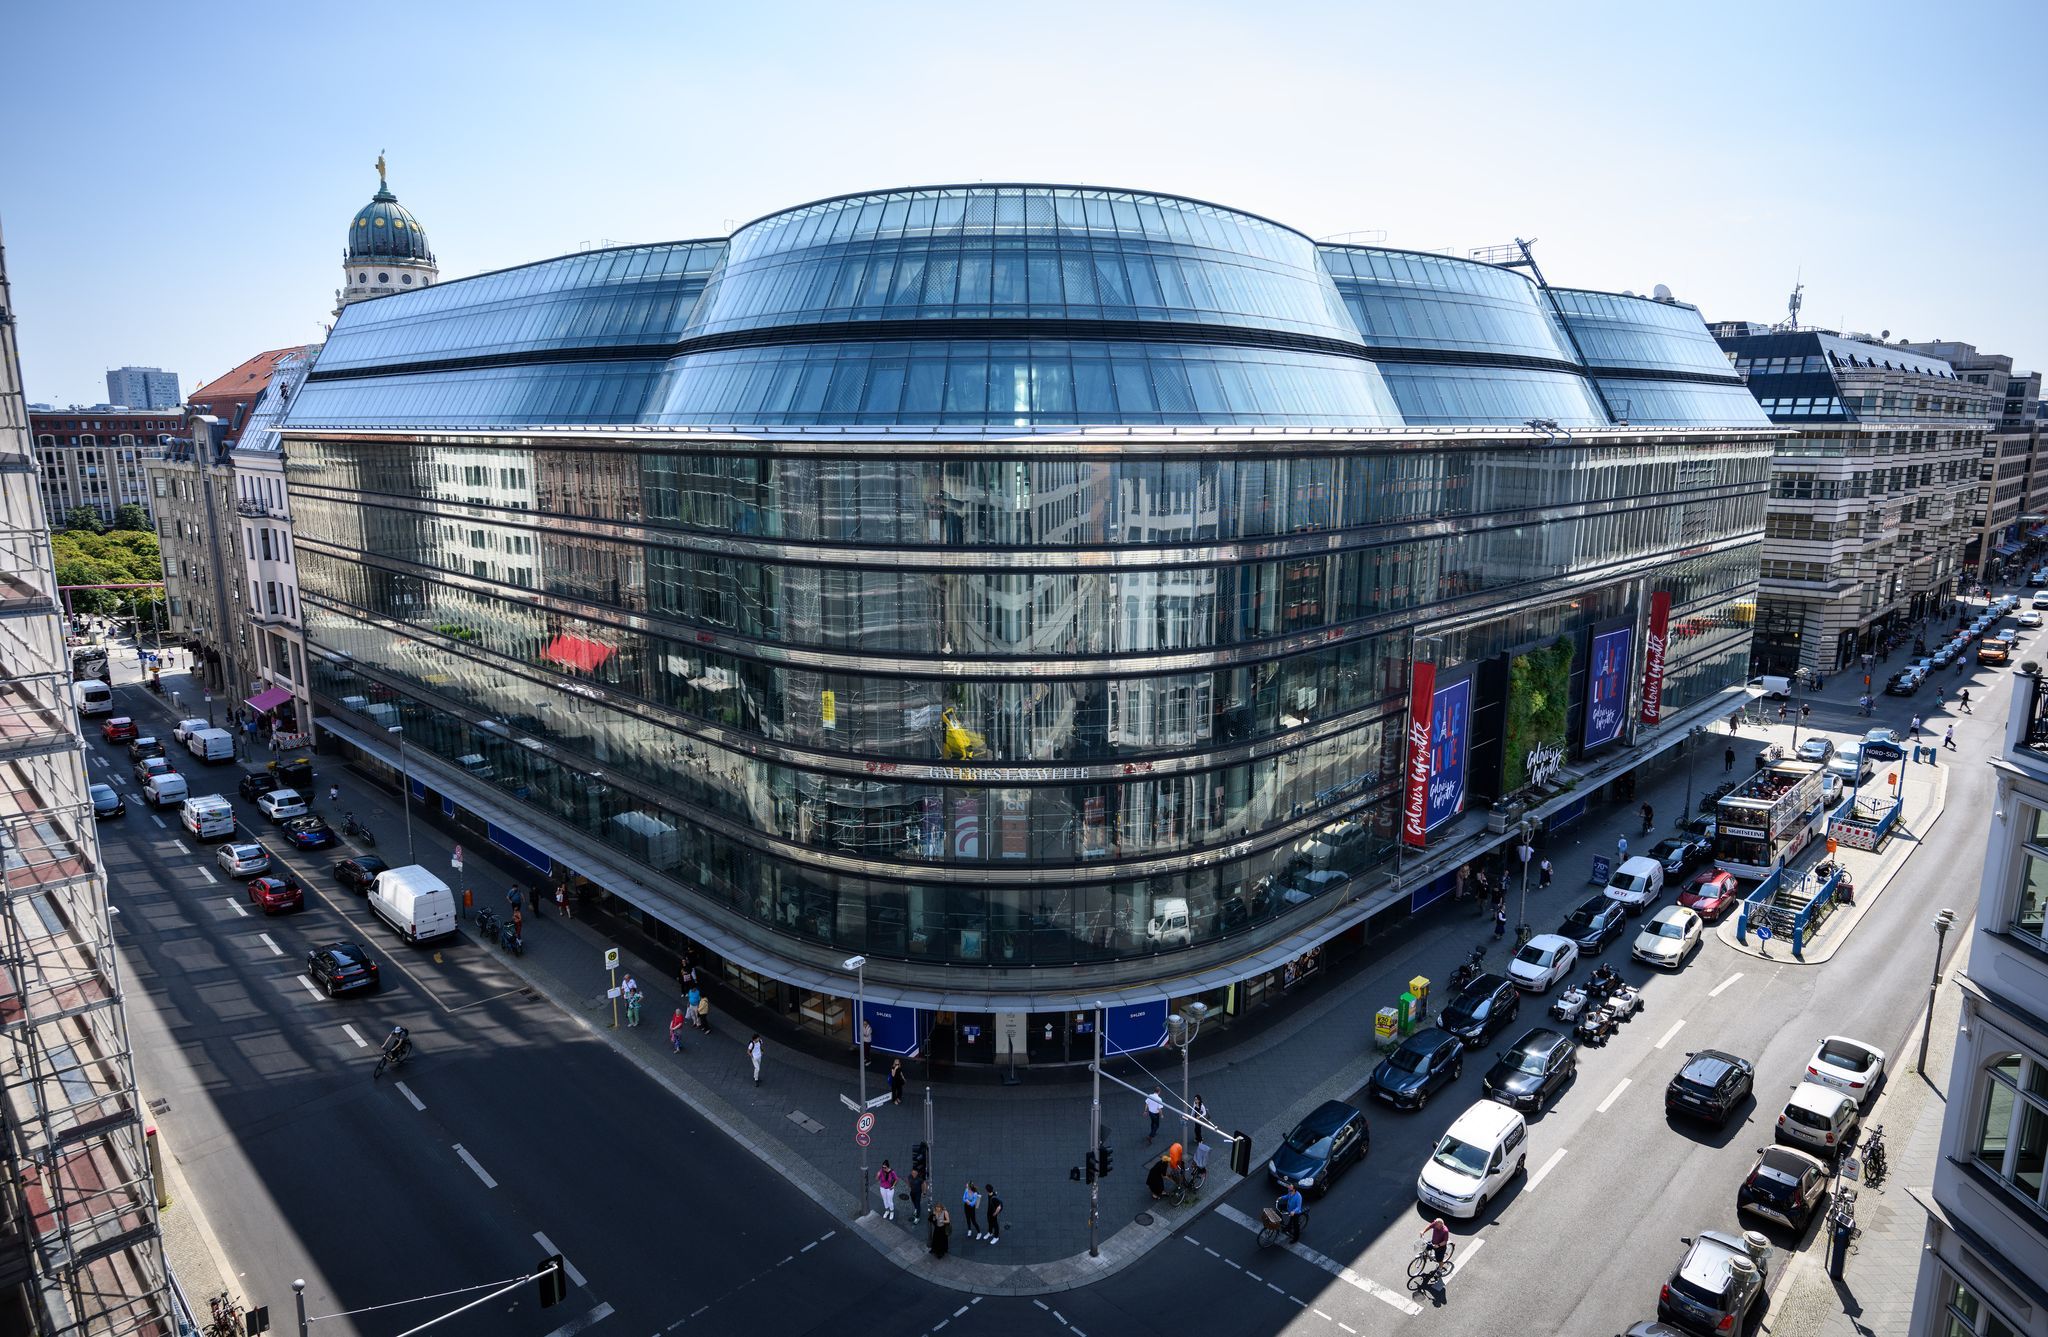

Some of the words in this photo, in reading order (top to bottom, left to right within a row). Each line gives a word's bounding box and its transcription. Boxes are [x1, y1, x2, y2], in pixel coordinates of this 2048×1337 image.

[1409, 716, 1431, 781] Lafayette
[1865, 748, 1899, 759] NORD-SÜD
[1431, 745, 1443, 778] LA
[929, 766, 1002, 780] GALERIES
[1006, 767, 1089, 780] LAFAYETTE
[1405, 784, 1427, 836] Galeries
[1727, 827, 1765, 838] SIGHTSEEING
[860, 1117, 871, 1129] 30
